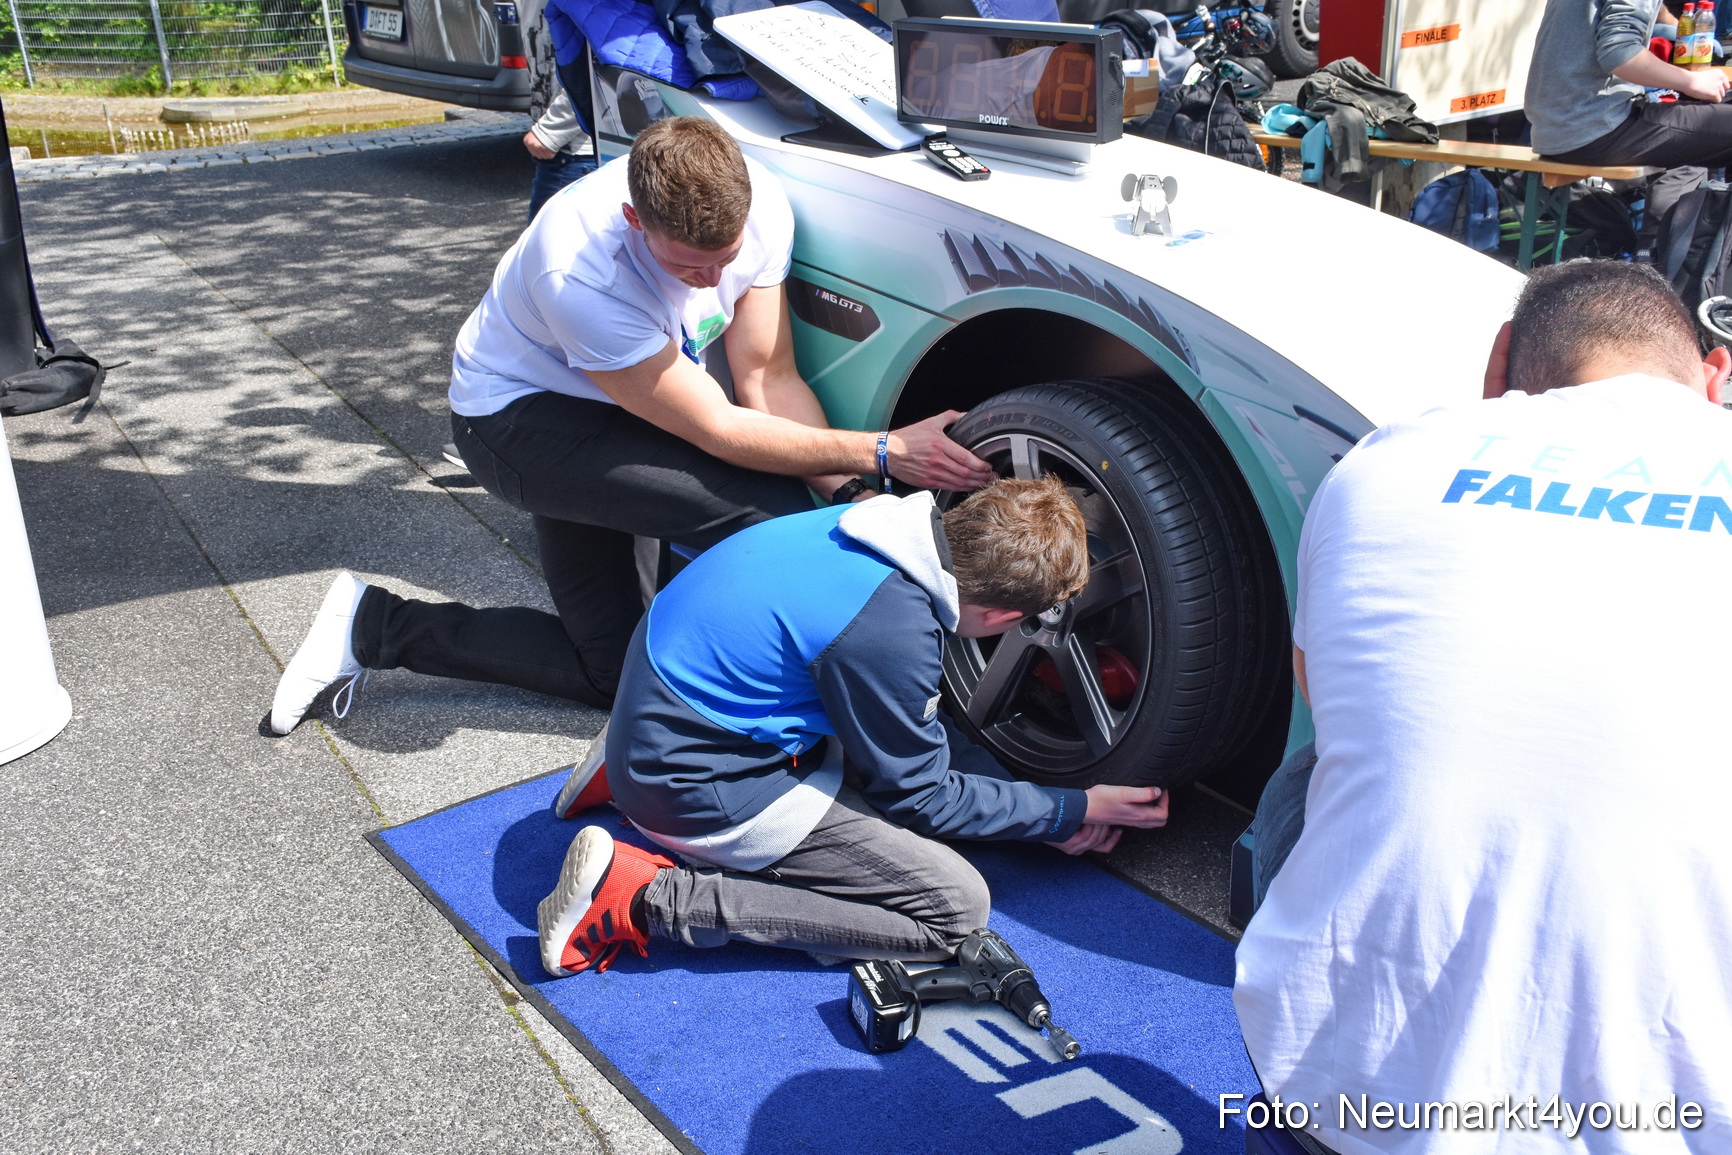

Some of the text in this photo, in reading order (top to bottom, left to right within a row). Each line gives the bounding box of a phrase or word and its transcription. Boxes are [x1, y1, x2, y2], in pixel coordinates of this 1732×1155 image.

[388, 13, 398, 32] 55
[1415, 28, 1447, 44] FINALE
[1460, 93, 1496, 110] 3. PLATZ
[820, 290, 864, 313] M6 GT3
[1441, 468, 1732, 535] FALKEN
